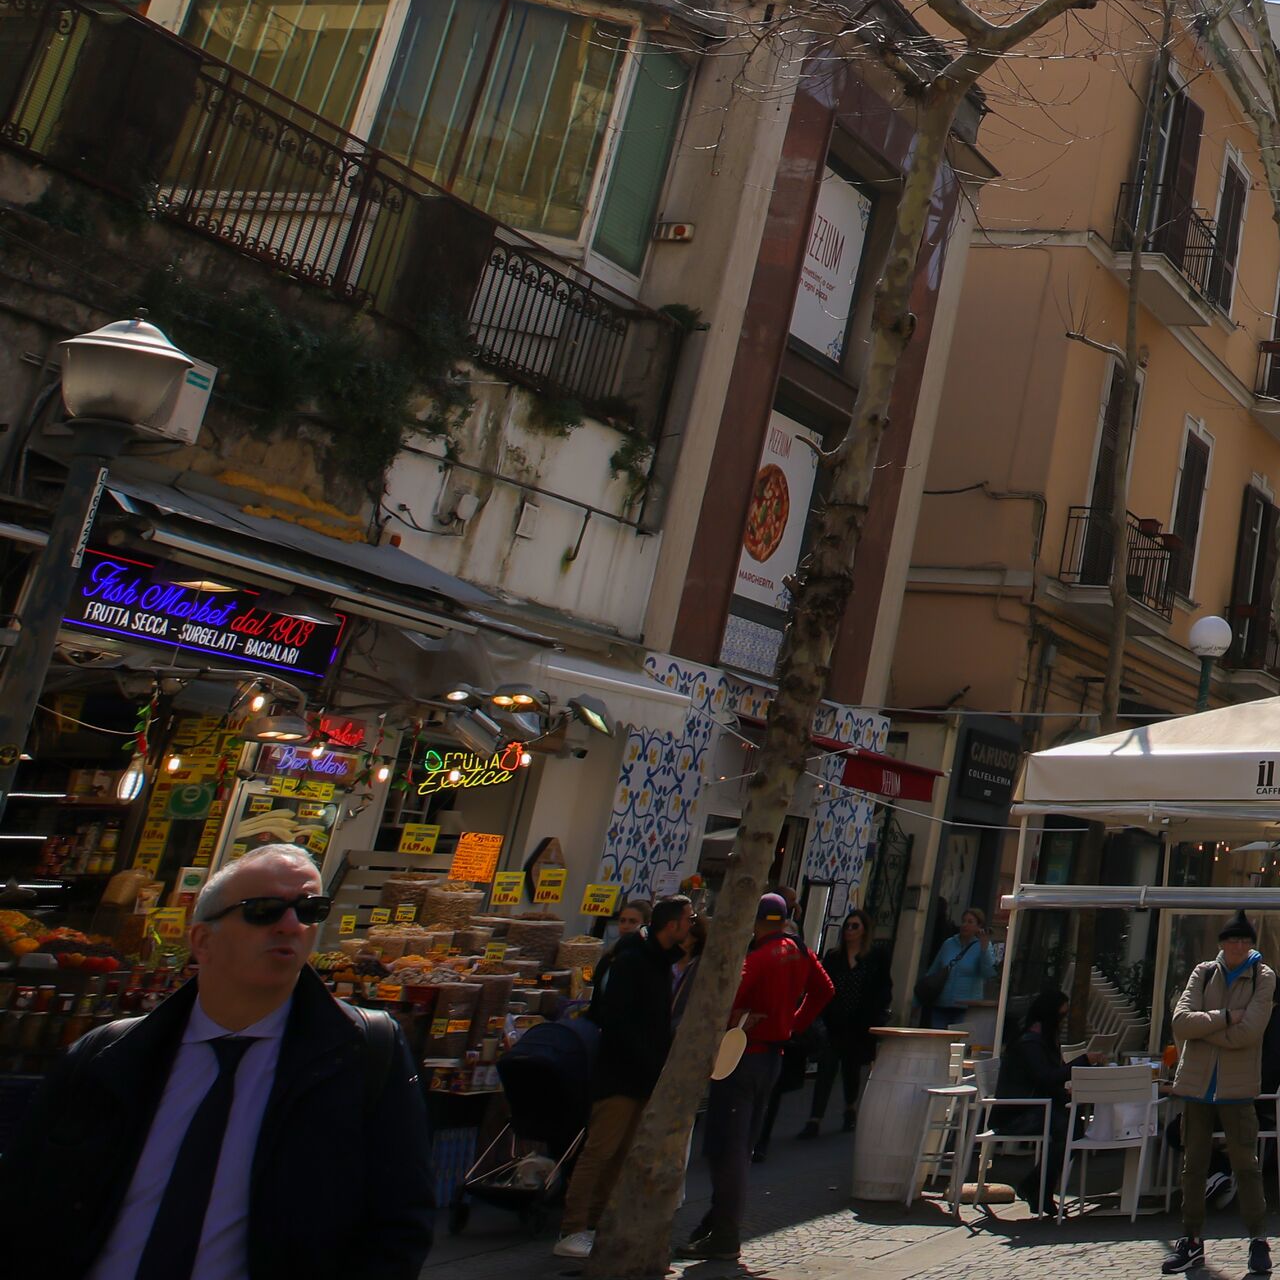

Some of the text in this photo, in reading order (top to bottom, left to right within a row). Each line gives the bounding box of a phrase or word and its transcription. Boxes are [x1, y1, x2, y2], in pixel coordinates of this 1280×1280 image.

[807, 212, 845, 276] IZZIUM
[739, 569, 774, 591] MARGHERITA
[82, 561, 139, 604] Fish
[230, 607, 265, 637] dal
[267, 613, 316, 647] 1903
[83, 601, 301, 665] FRUTTA SECCA SURGELATI BACCALARI
[970, 741, 1017, 771] CARUSO
[968, 768, 1011, 787] COLTELLERIA
[1256, 760, 1275, 787] il
